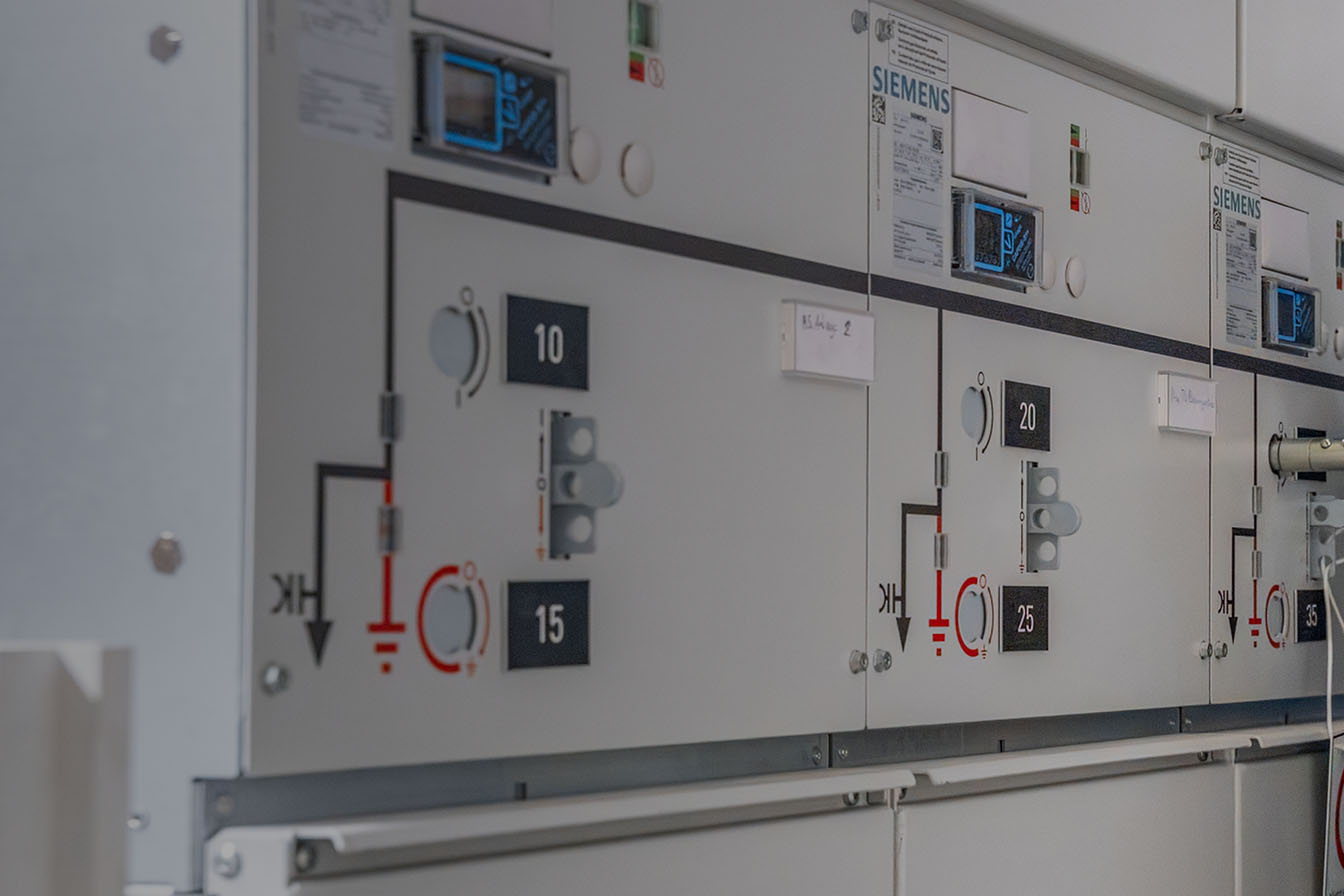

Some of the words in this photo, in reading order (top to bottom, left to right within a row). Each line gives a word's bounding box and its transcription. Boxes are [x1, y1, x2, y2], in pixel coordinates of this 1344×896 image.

[872, 65, 951, 115] SIEMENS
[1213, 185, 1262, 219] SIEMENS
[534, 323, 565, 364] 10
[1019, 402, 1036, 431] 20
[535, 604, 565, 644] 15
[1018, 605, 1034, 633] 25
[1306, 604, 1318, 627] 35
